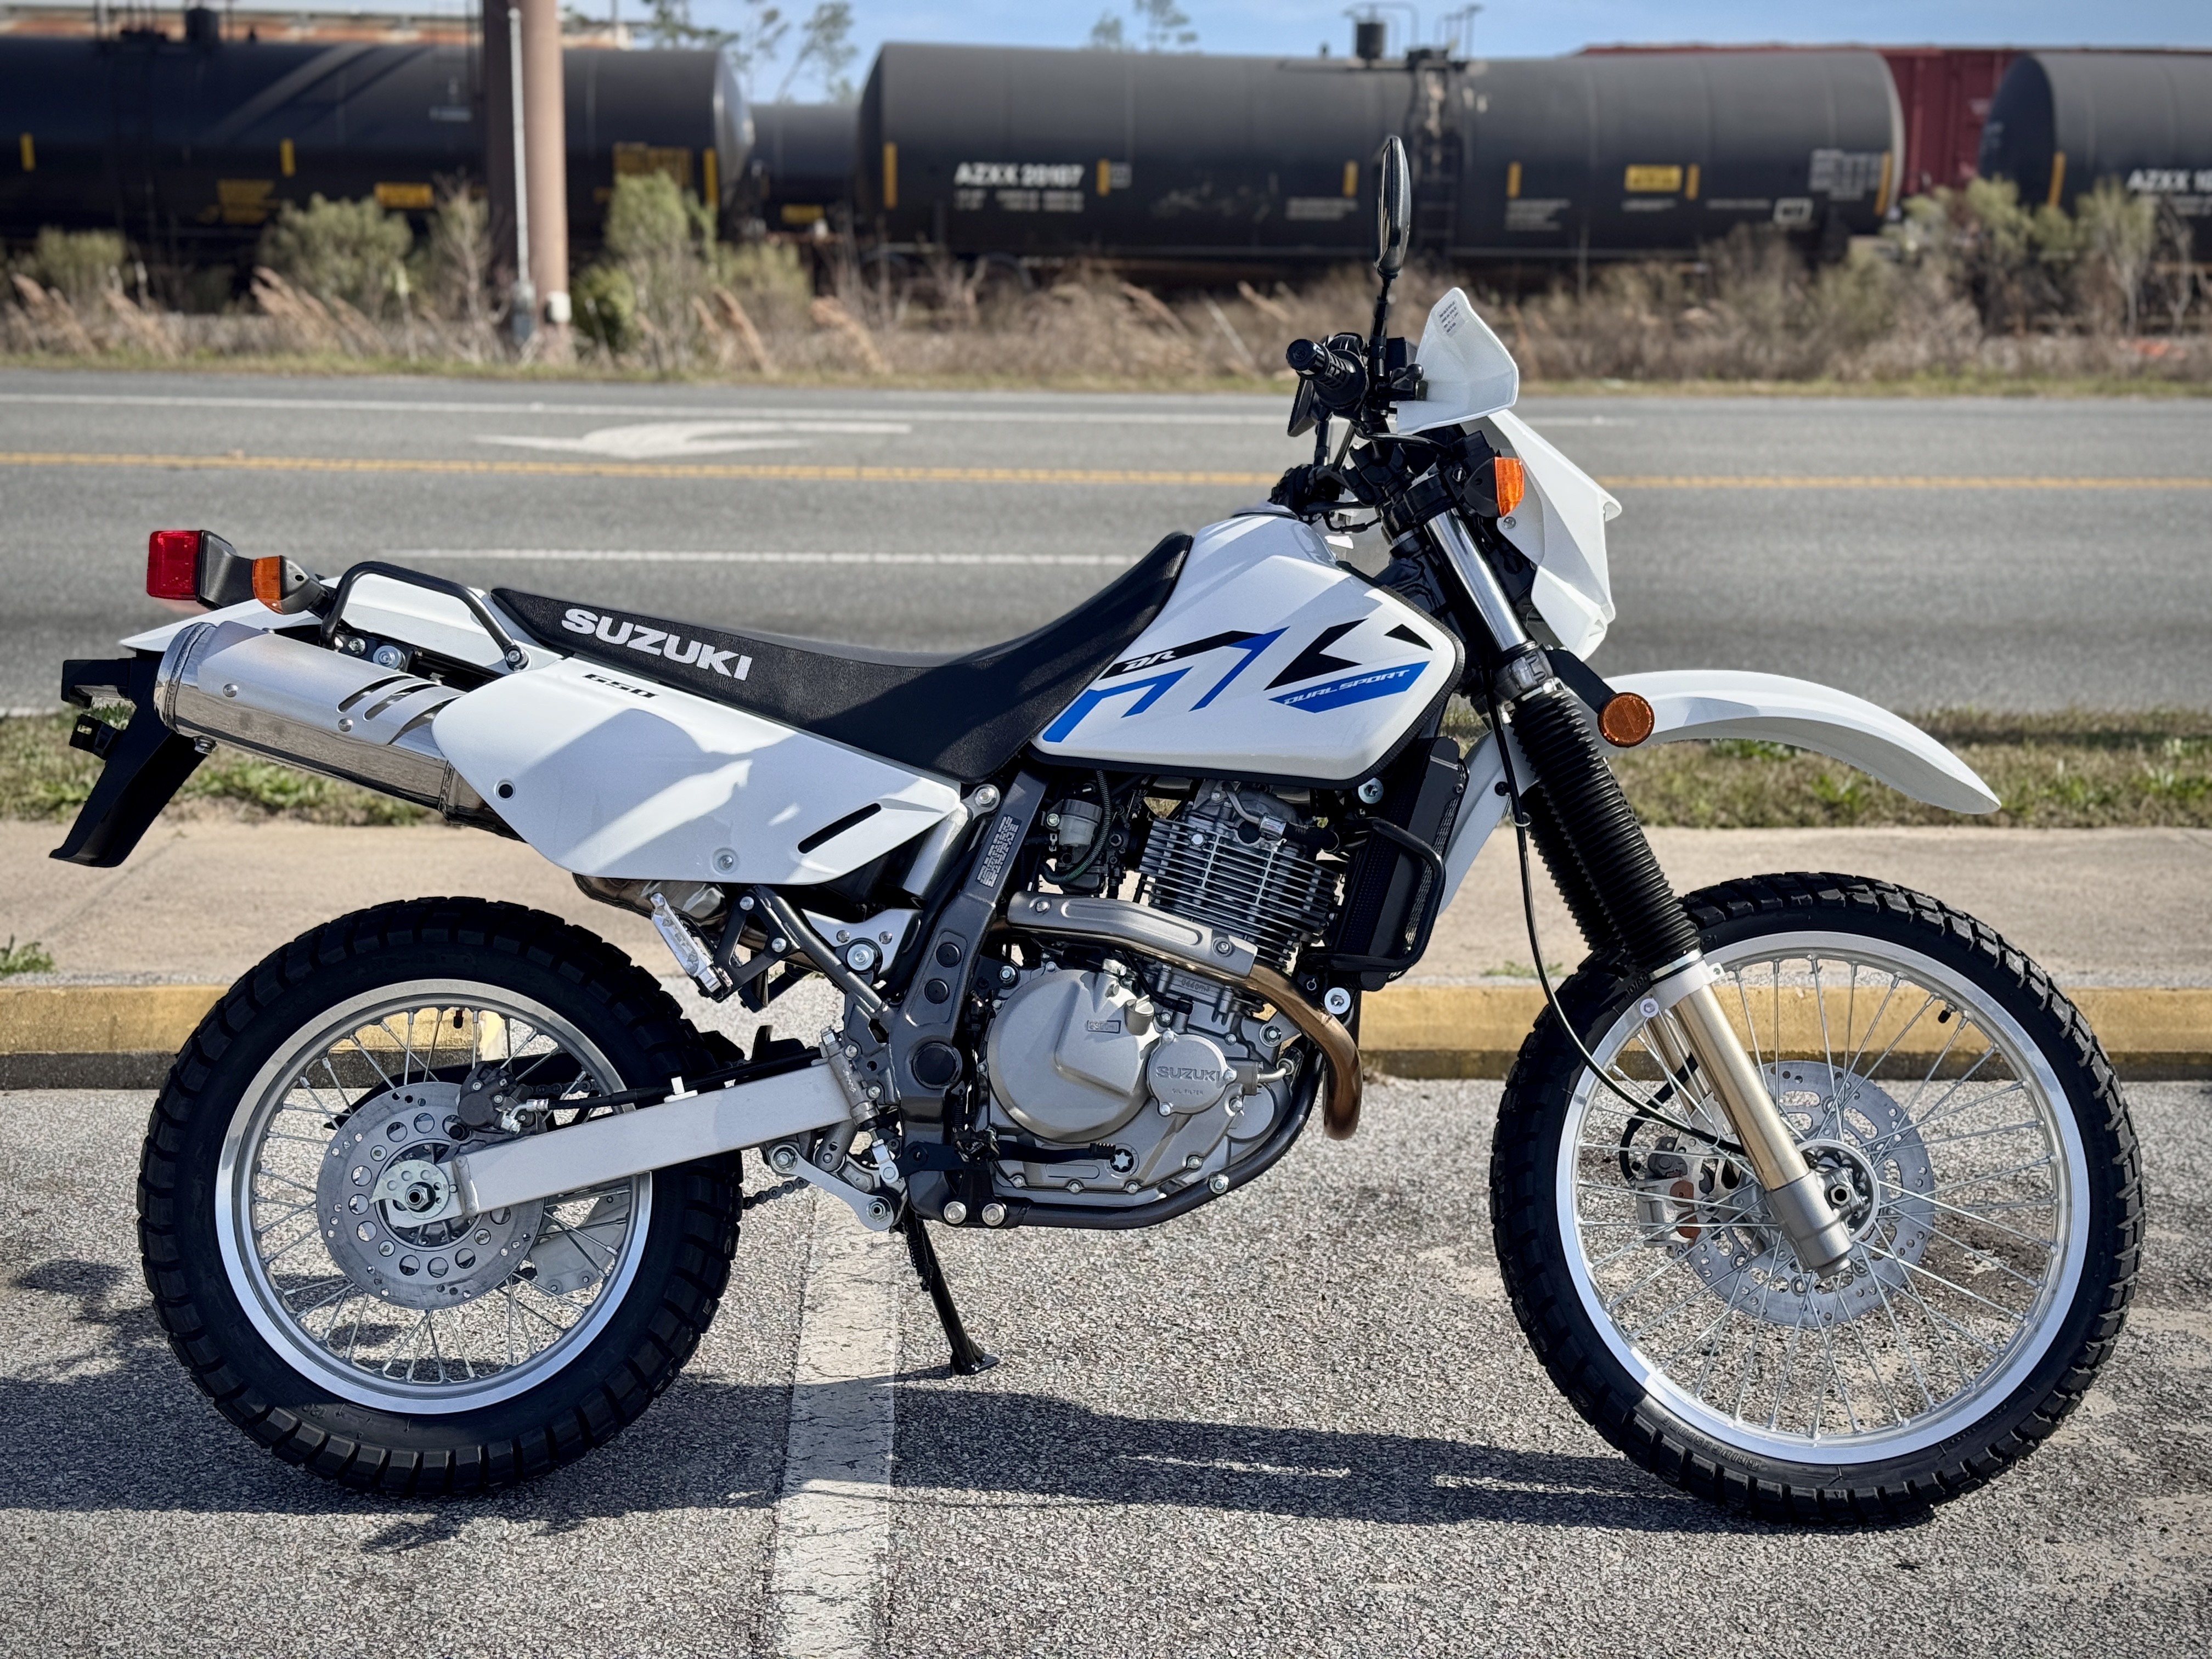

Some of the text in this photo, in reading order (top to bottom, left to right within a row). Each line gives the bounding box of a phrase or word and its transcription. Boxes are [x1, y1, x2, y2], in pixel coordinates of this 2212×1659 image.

[955, 162, 1017, 185] AZXX
[2126, 168, 2190, 191] AZXX
[562, 608, 752, 681] SUZUKI
[1122, 650, 1177, 672] DR
[582, 674, 659, 698] 650
[1283, 669, 1410, 705] DUAL SPORT
[1156, 1066, 1220, 1082] SUZUKI
